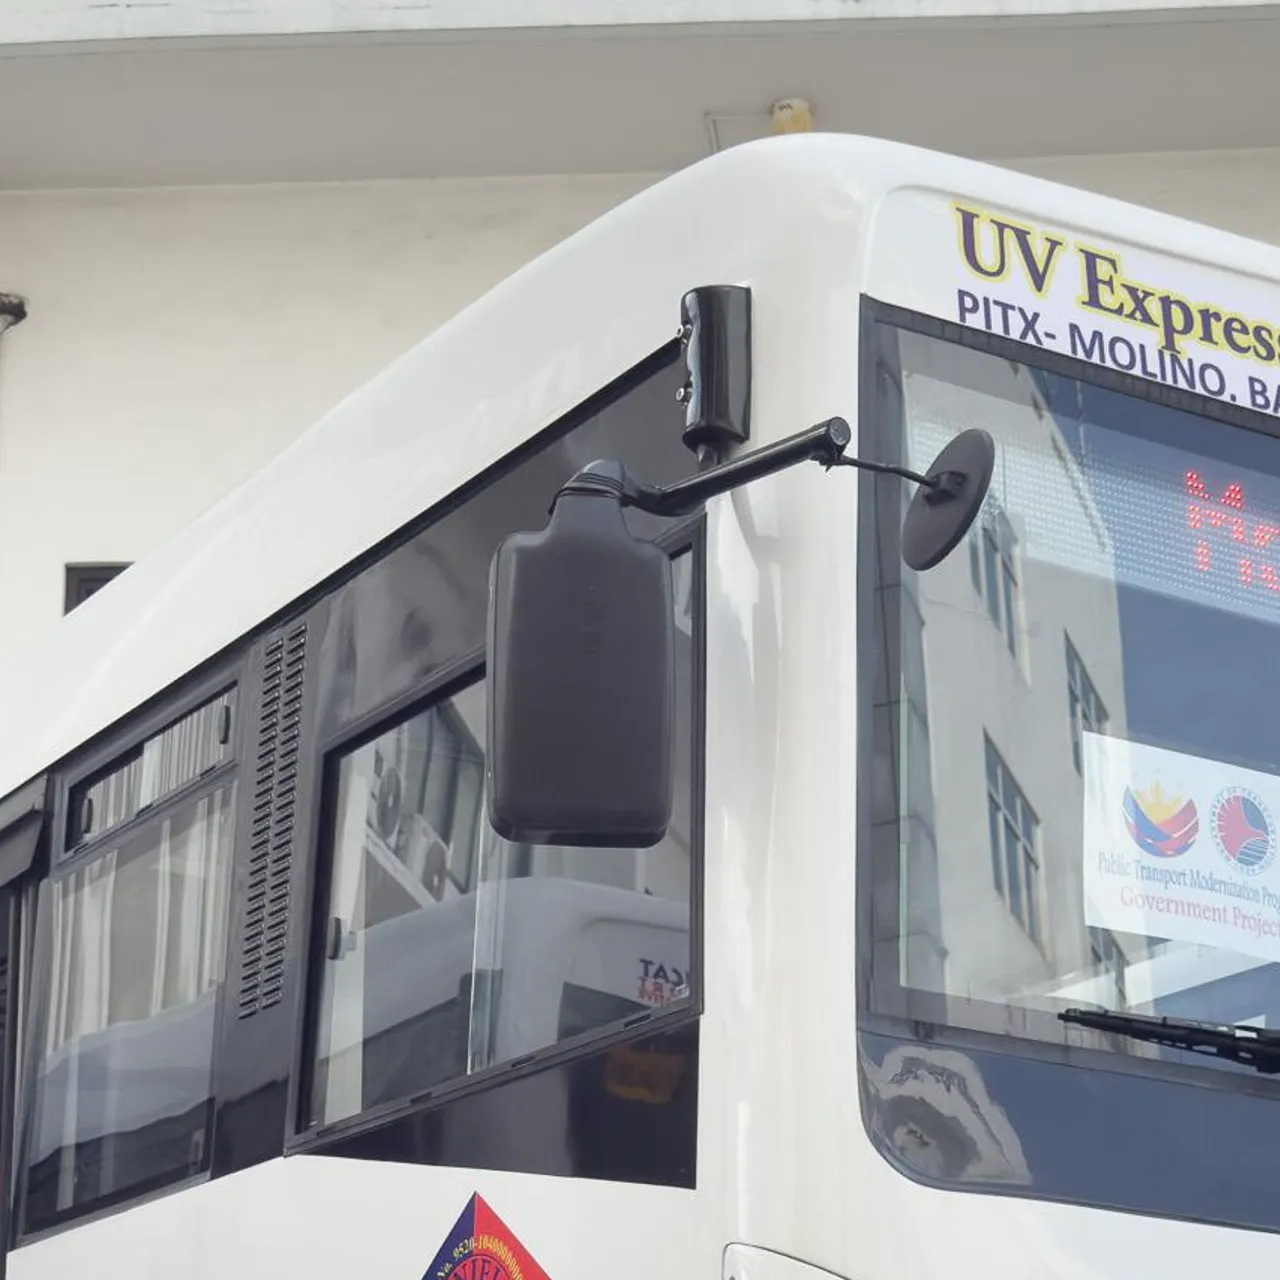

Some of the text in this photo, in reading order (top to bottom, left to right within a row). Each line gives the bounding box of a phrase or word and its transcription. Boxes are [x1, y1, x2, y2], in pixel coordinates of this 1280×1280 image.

[955, 204, 1062, 296] UV
[958, 288, 1058, 346] PITX-
[1098, 851, 1132, 877] Public
[1134, 860, 1188, 890] Transport
[1190, 869, 1260, 904] Modernization
[1120, 886, 1231, 924] Government
